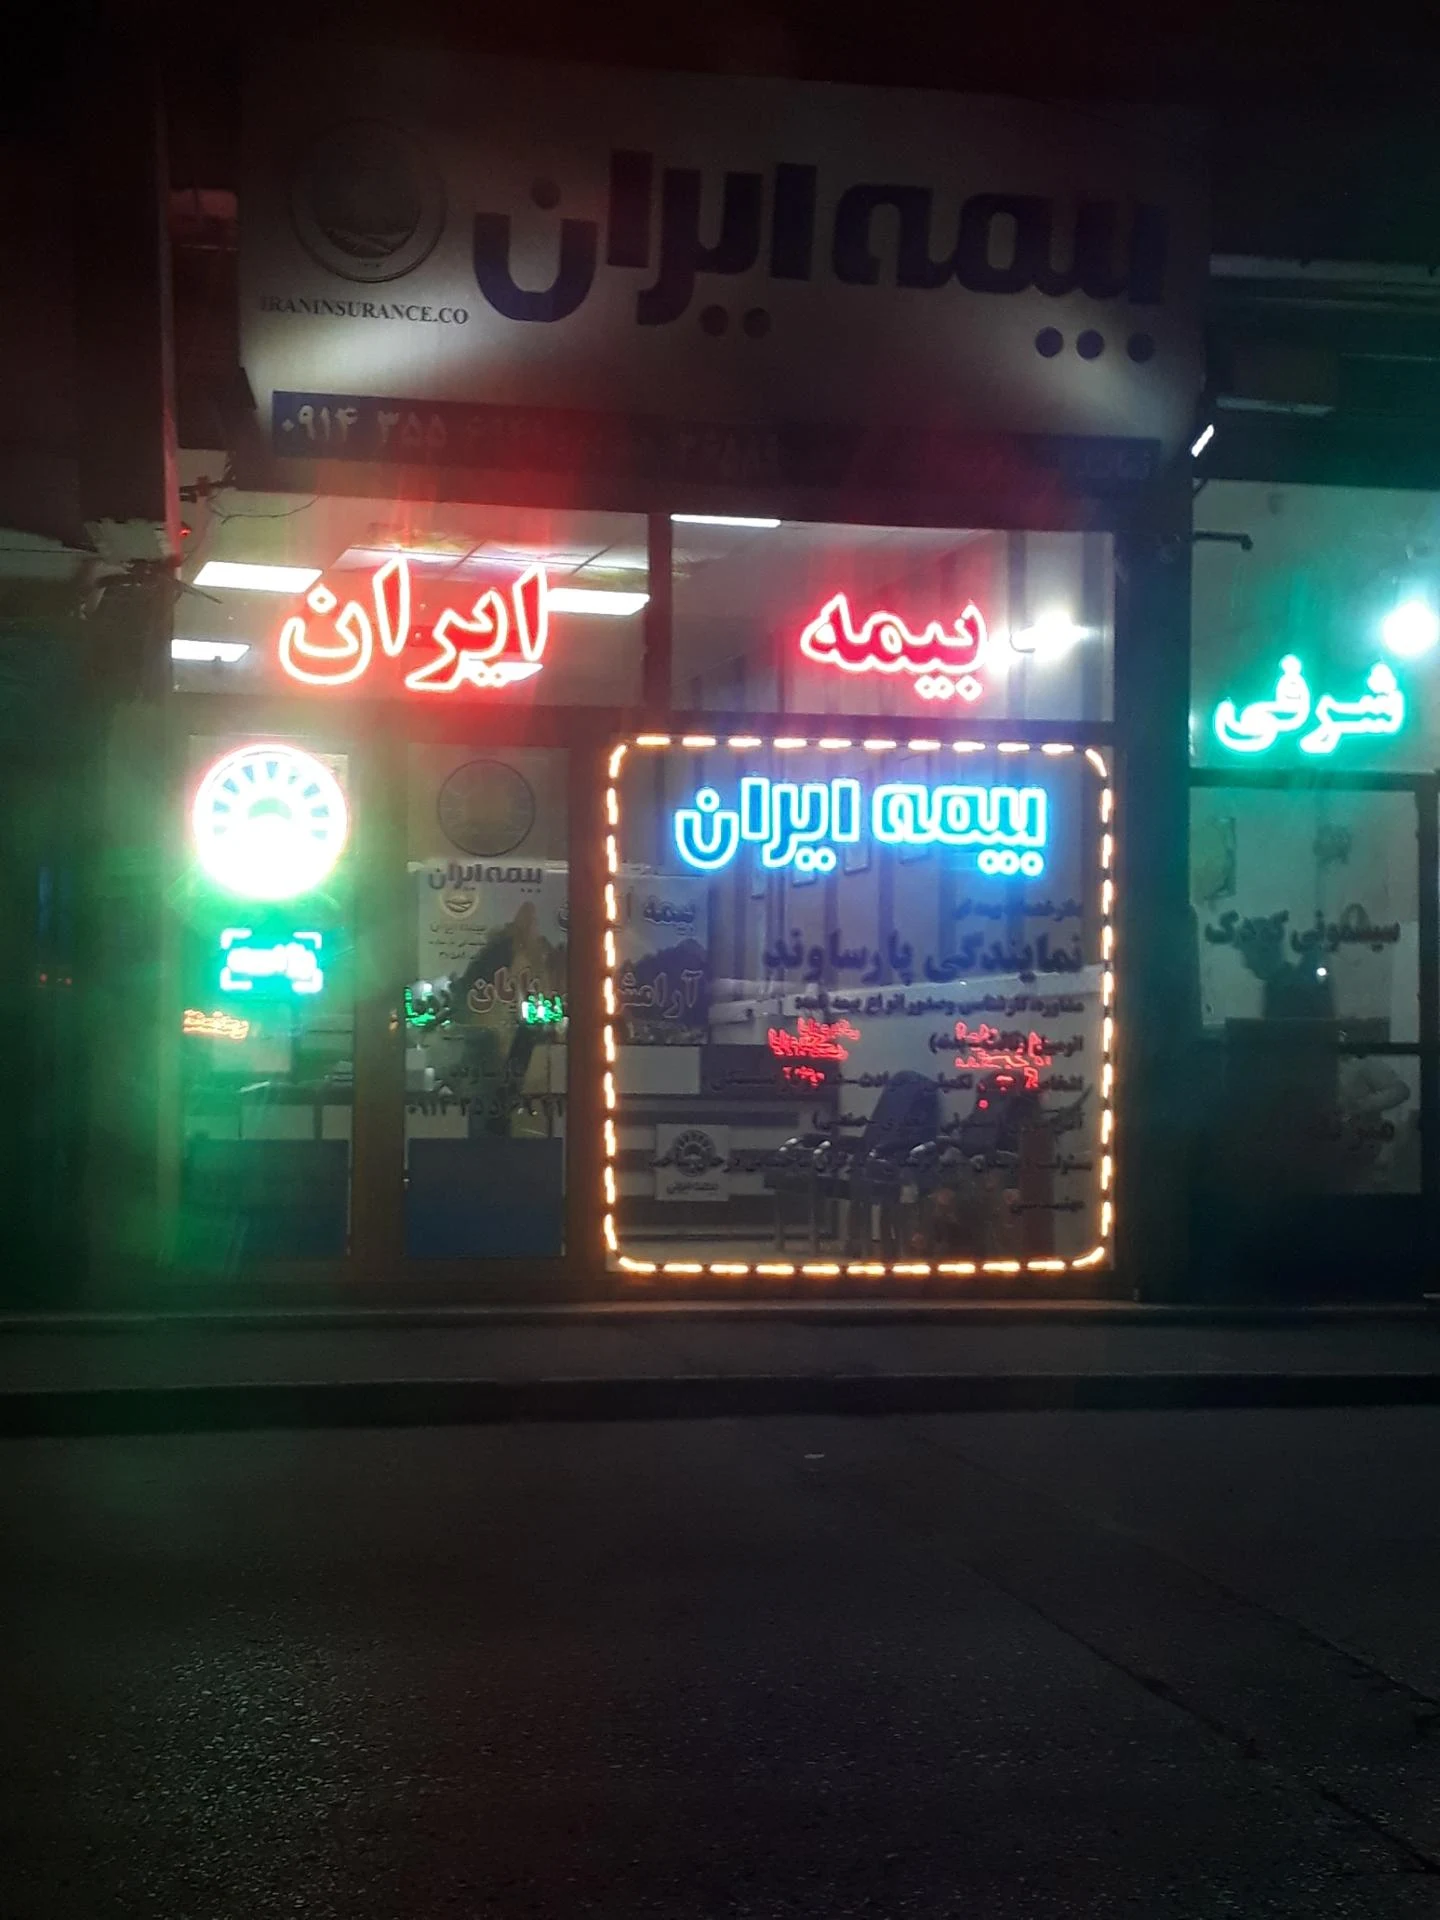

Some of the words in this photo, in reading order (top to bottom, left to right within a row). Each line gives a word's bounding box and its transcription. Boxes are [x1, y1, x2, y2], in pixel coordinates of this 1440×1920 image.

[472, 149, 818, 341] ایران
[832, 181, 1168, 363] بیمه
[278, 556, 549, 692] ایران
[799, 591, 988, 702] بیمه
[674, 775, 863, 873] ایران
[871, 781, 1049, 878] بیمه
[428, 861, 484, 892] ایران
[486, 863, 542, 894] بیمه
[764, 928, 913, 988] پارساوند
[922, 932, 1084, 984] نمایندگی
